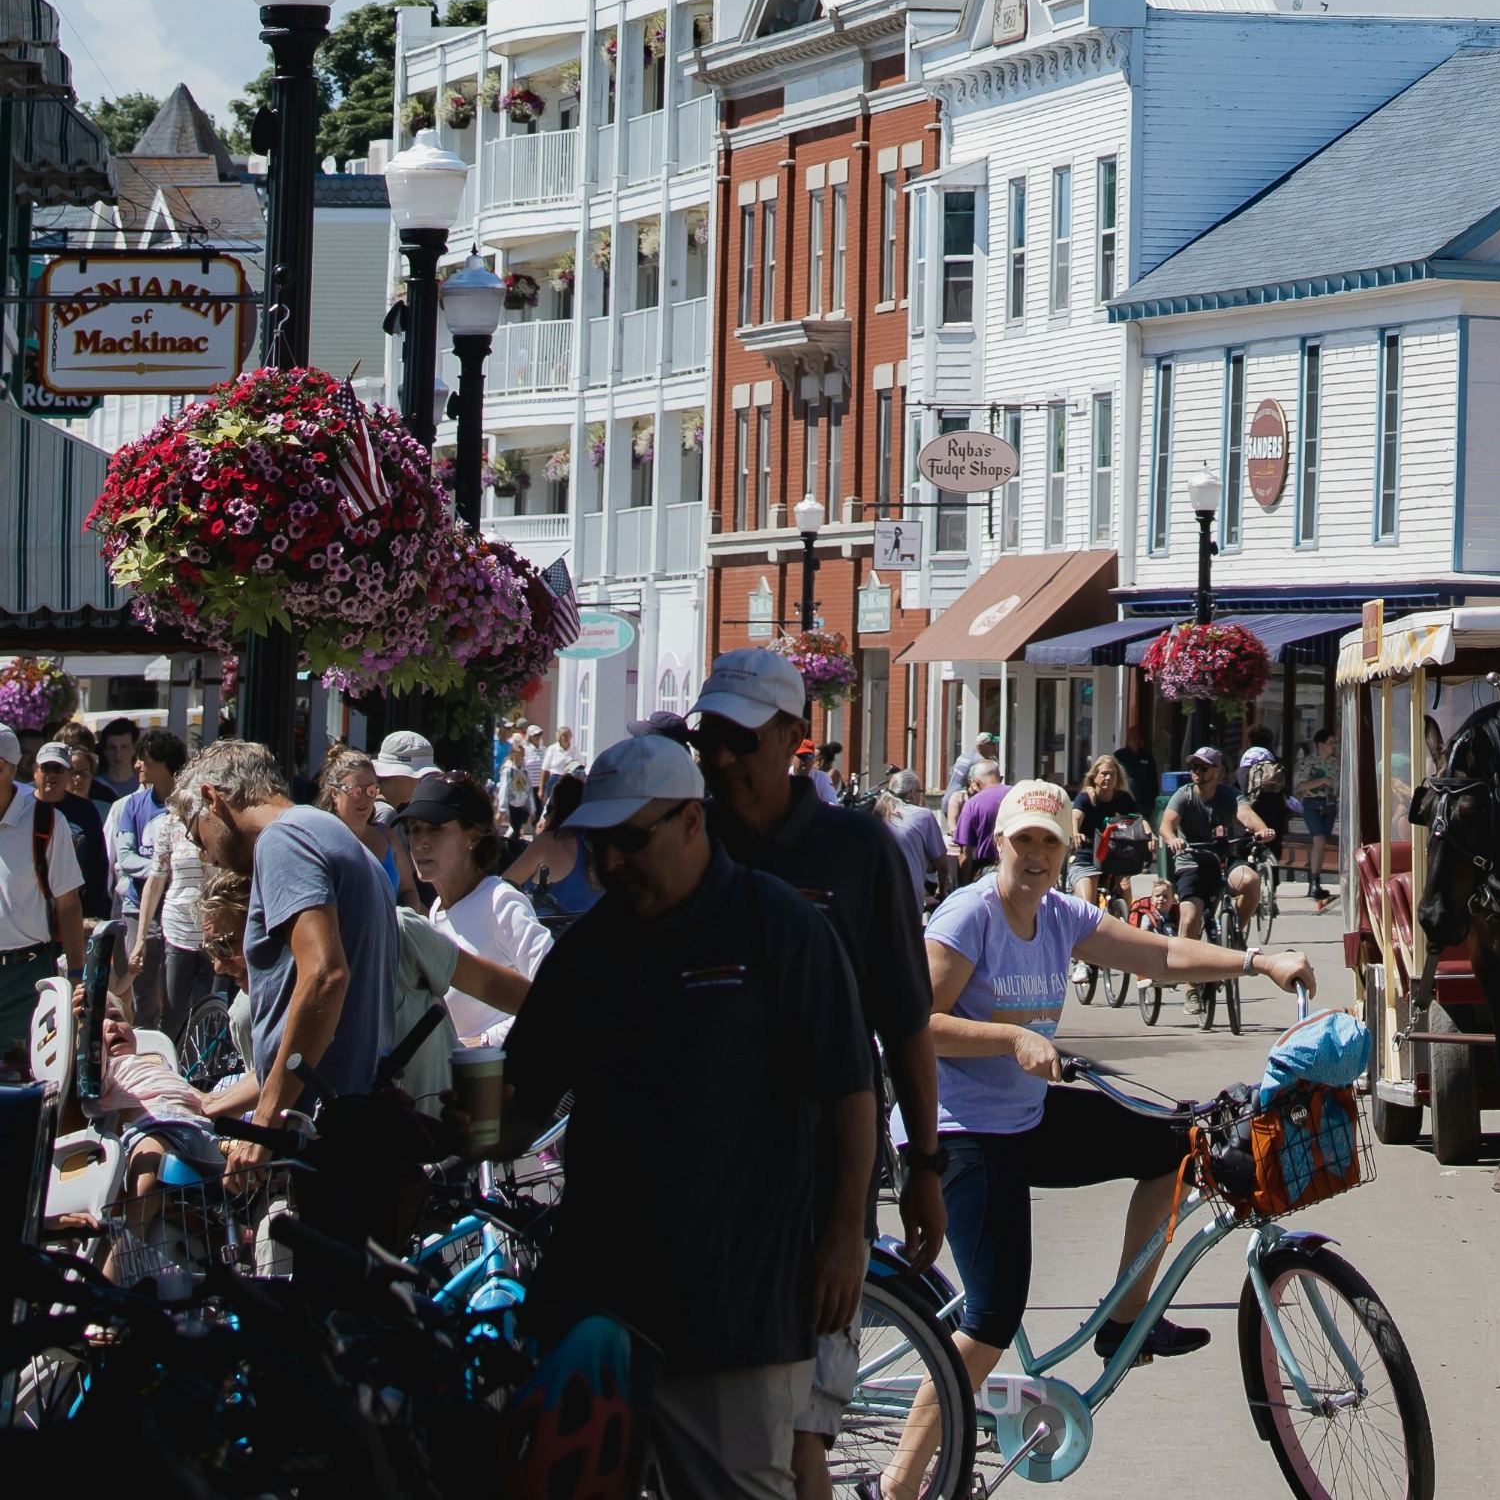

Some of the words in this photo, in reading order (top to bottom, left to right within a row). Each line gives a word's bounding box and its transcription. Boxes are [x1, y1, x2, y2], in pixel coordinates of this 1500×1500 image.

[56, 276, 234, 328] BENJAMIN
[131, 308, 154, 324] of
[72, 329, 210, 355] Mackinac
[948, 438, 992, 462] Ryba's
[1248, 435, 1283, 460] SANDERS
[926, 458, 966, 480] Fudge
[970, 460, 1011, 481] Shops
